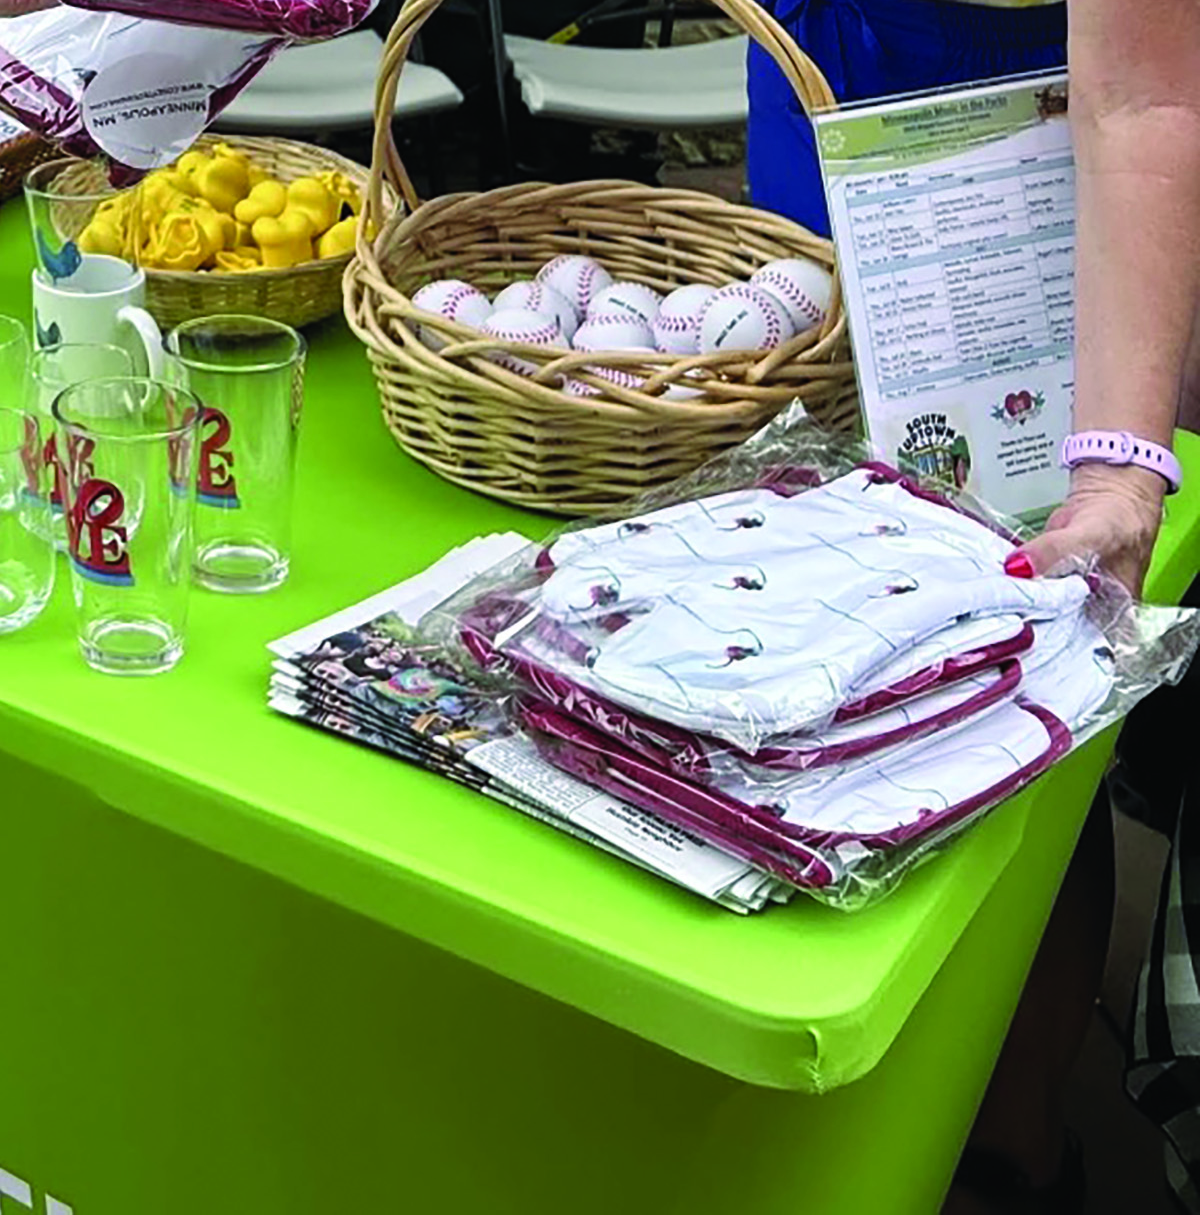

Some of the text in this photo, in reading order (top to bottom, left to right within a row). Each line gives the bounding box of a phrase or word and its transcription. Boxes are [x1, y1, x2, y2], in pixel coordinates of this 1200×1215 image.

[92, 114, 117, 128] MN
[905, 413, 947, 434] SOUTH
[902, 425, 957, 451] UPTOWN
